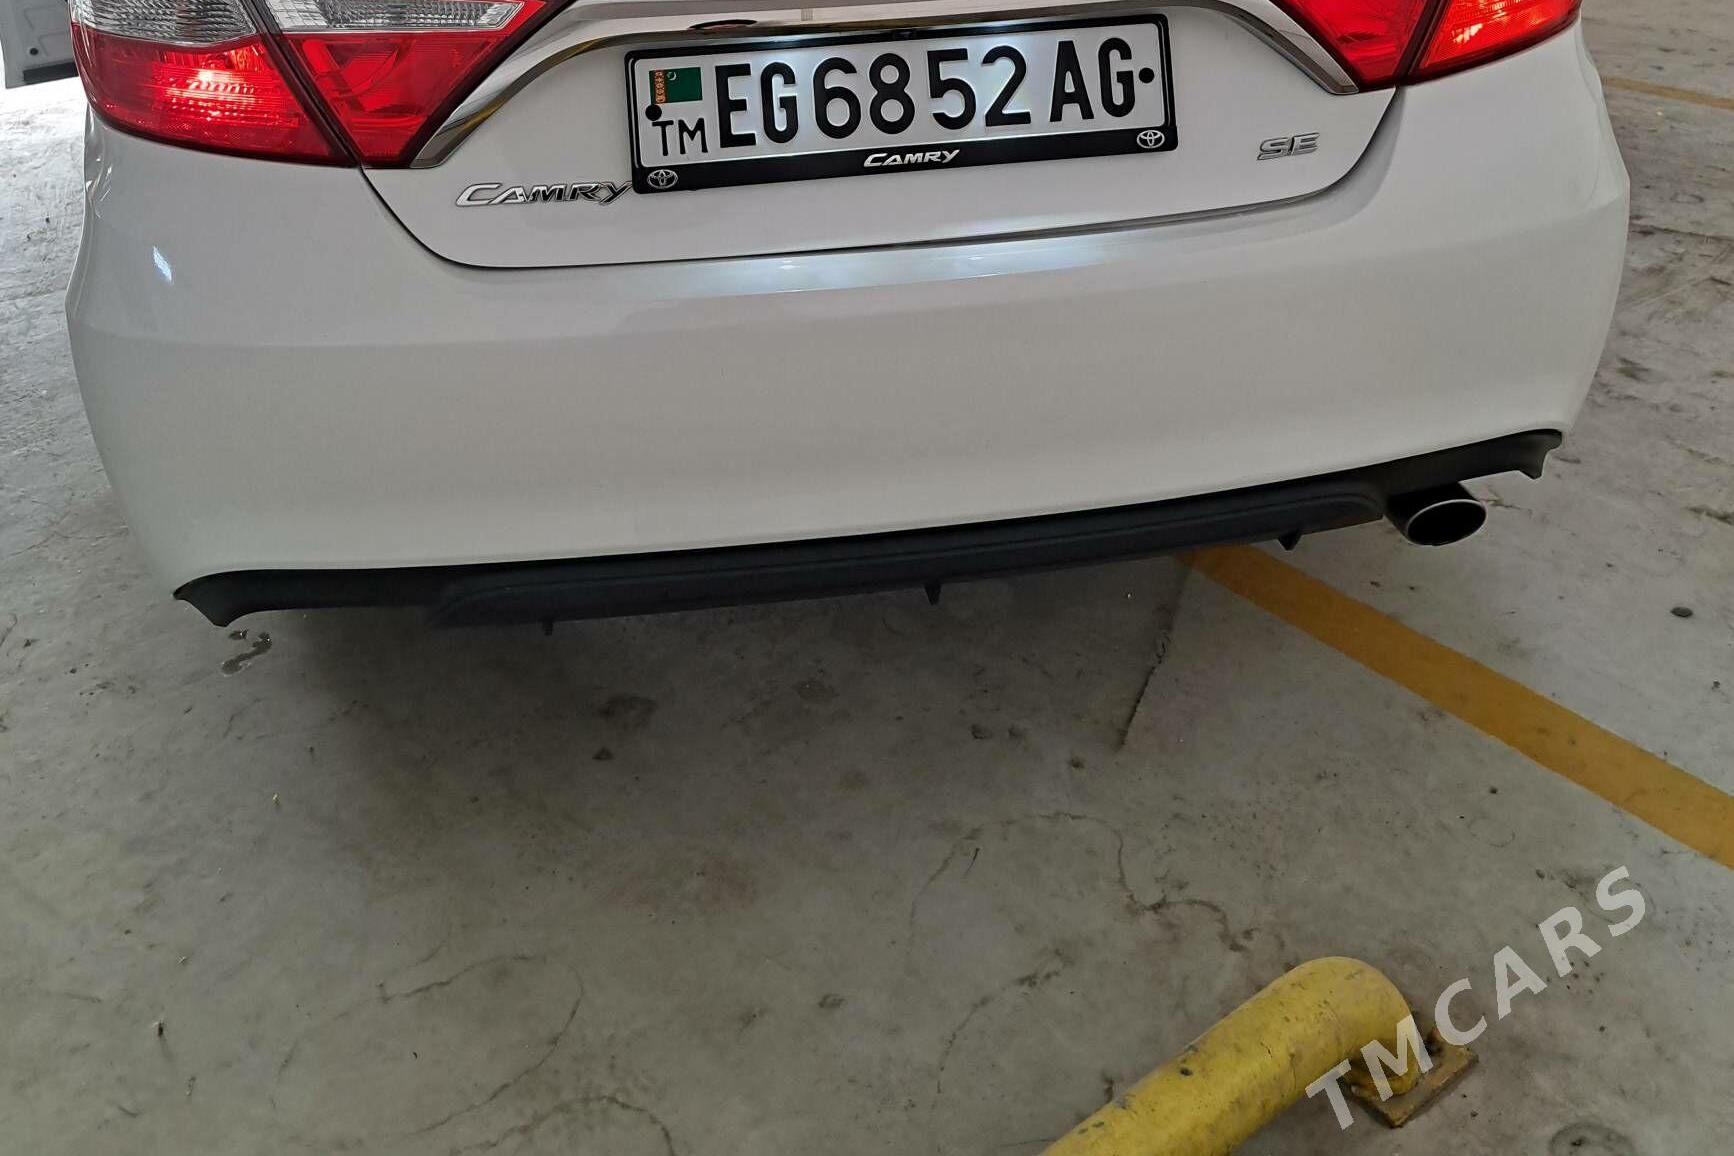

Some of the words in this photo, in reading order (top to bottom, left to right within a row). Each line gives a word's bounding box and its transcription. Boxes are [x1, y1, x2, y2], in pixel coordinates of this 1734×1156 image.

[652, 117, 709, 157] TM
[1257, 132, 1320, 161] SE
[863, 149, 960, 167] CAMRY
[456, 182, 634, 207] CAMRY
